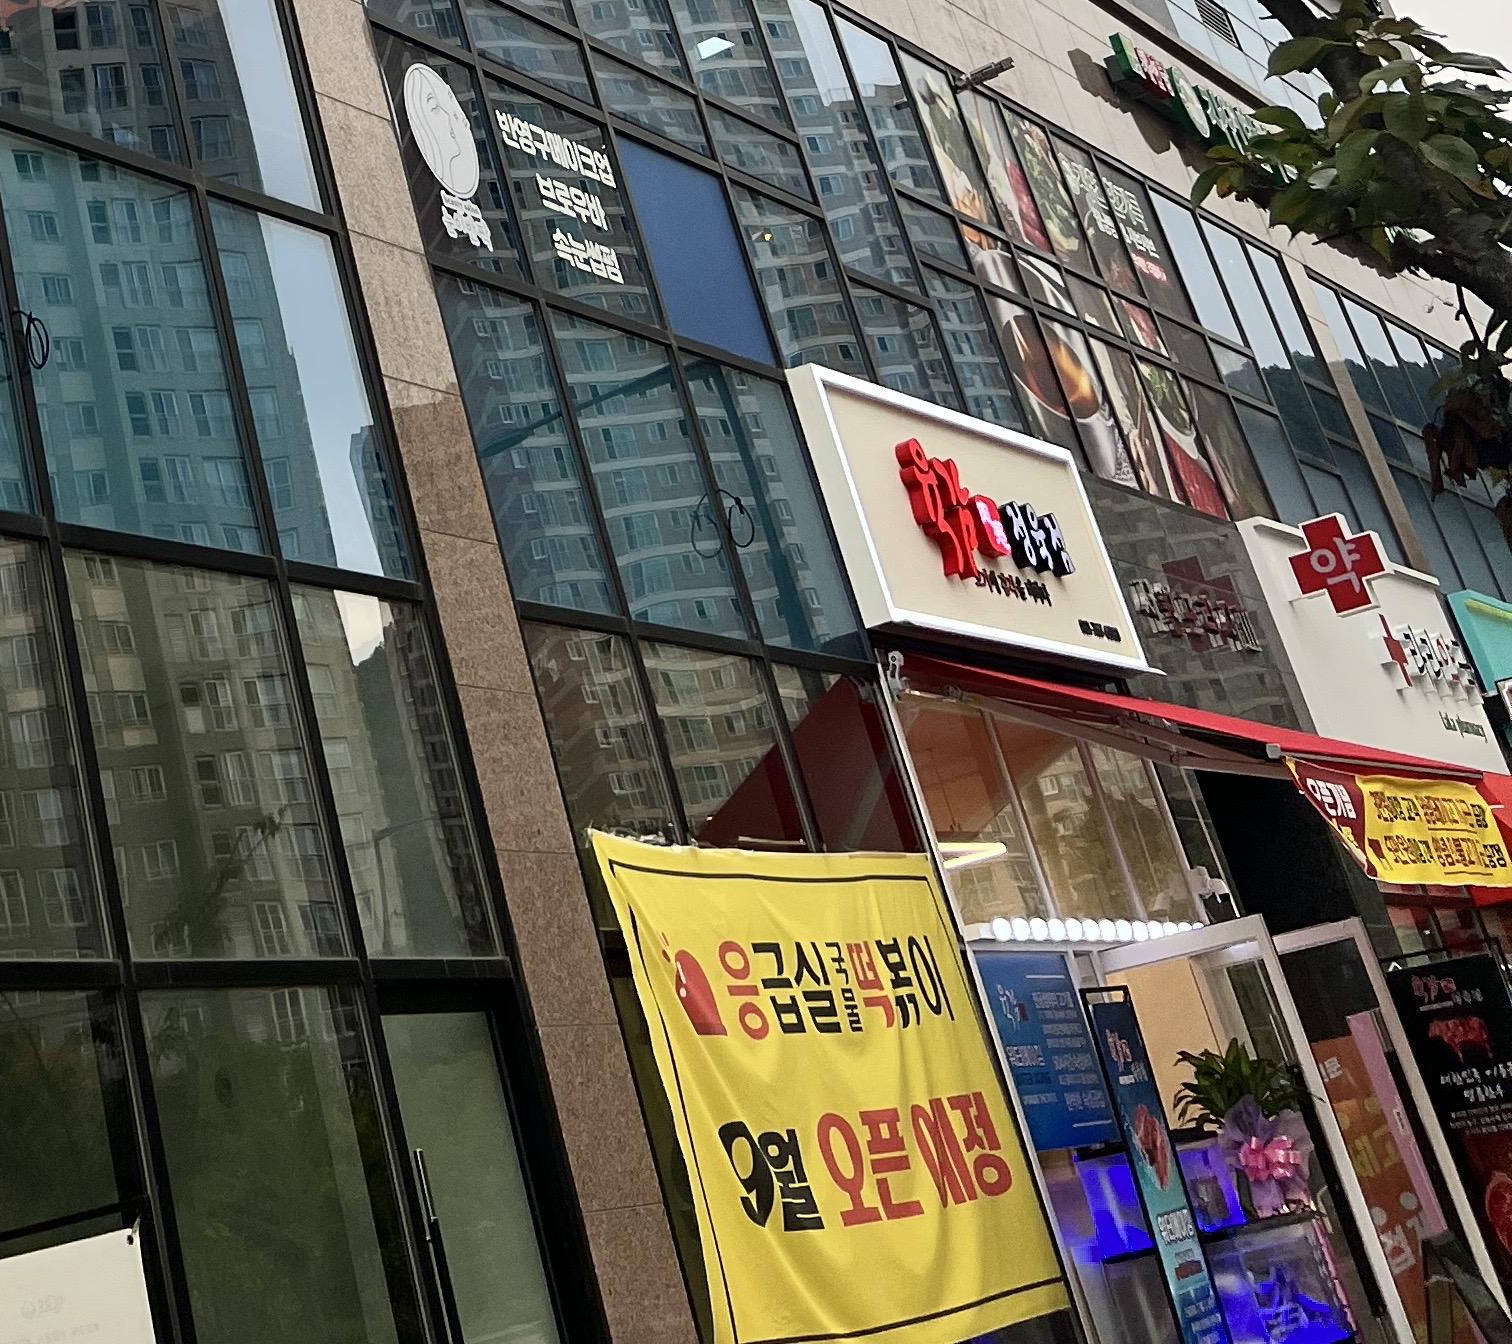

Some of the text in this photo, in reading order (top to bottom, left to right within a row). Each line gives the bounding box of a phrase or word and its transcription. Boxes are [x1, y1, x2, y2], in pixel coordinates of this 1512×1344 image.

[495, 109, 617, 189] 반영구메이크업
[535, 172, 609, 231] 브로우바
[552, 227, 625, 285] 속눈썹펌
[999, 500, 1077, 578] 정육점
[1308, 536, 1362, 595] 약
[717, 1091, 1014, 1234] 9월 오픈예정
